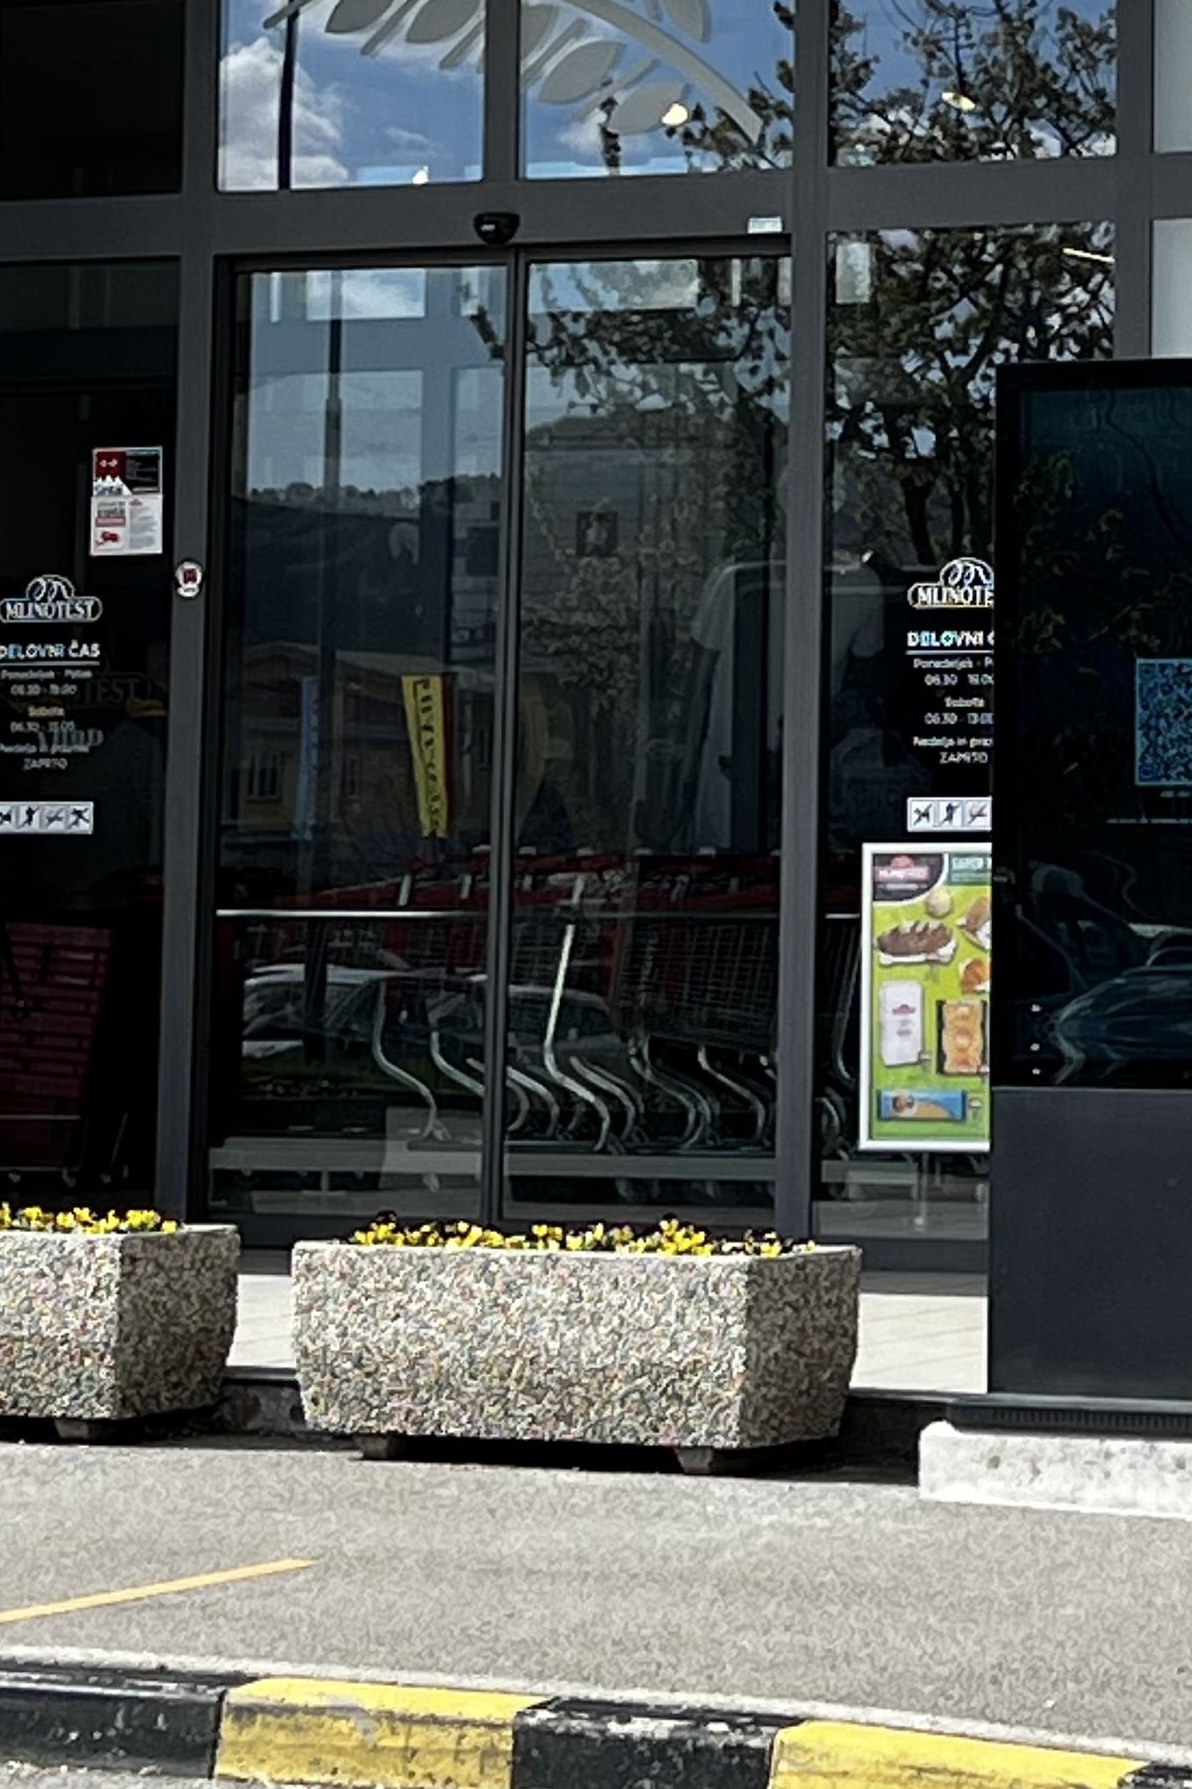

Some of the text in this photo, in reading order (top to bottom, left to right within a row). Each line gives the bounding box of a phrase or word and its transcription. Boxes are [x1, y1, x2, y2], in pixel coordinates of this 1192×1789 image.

[5, 601, 95, 620] MLINOTEST
[907, 631, 983, 646] DELOVNI
[68, 639, 100, 658] ČAS
